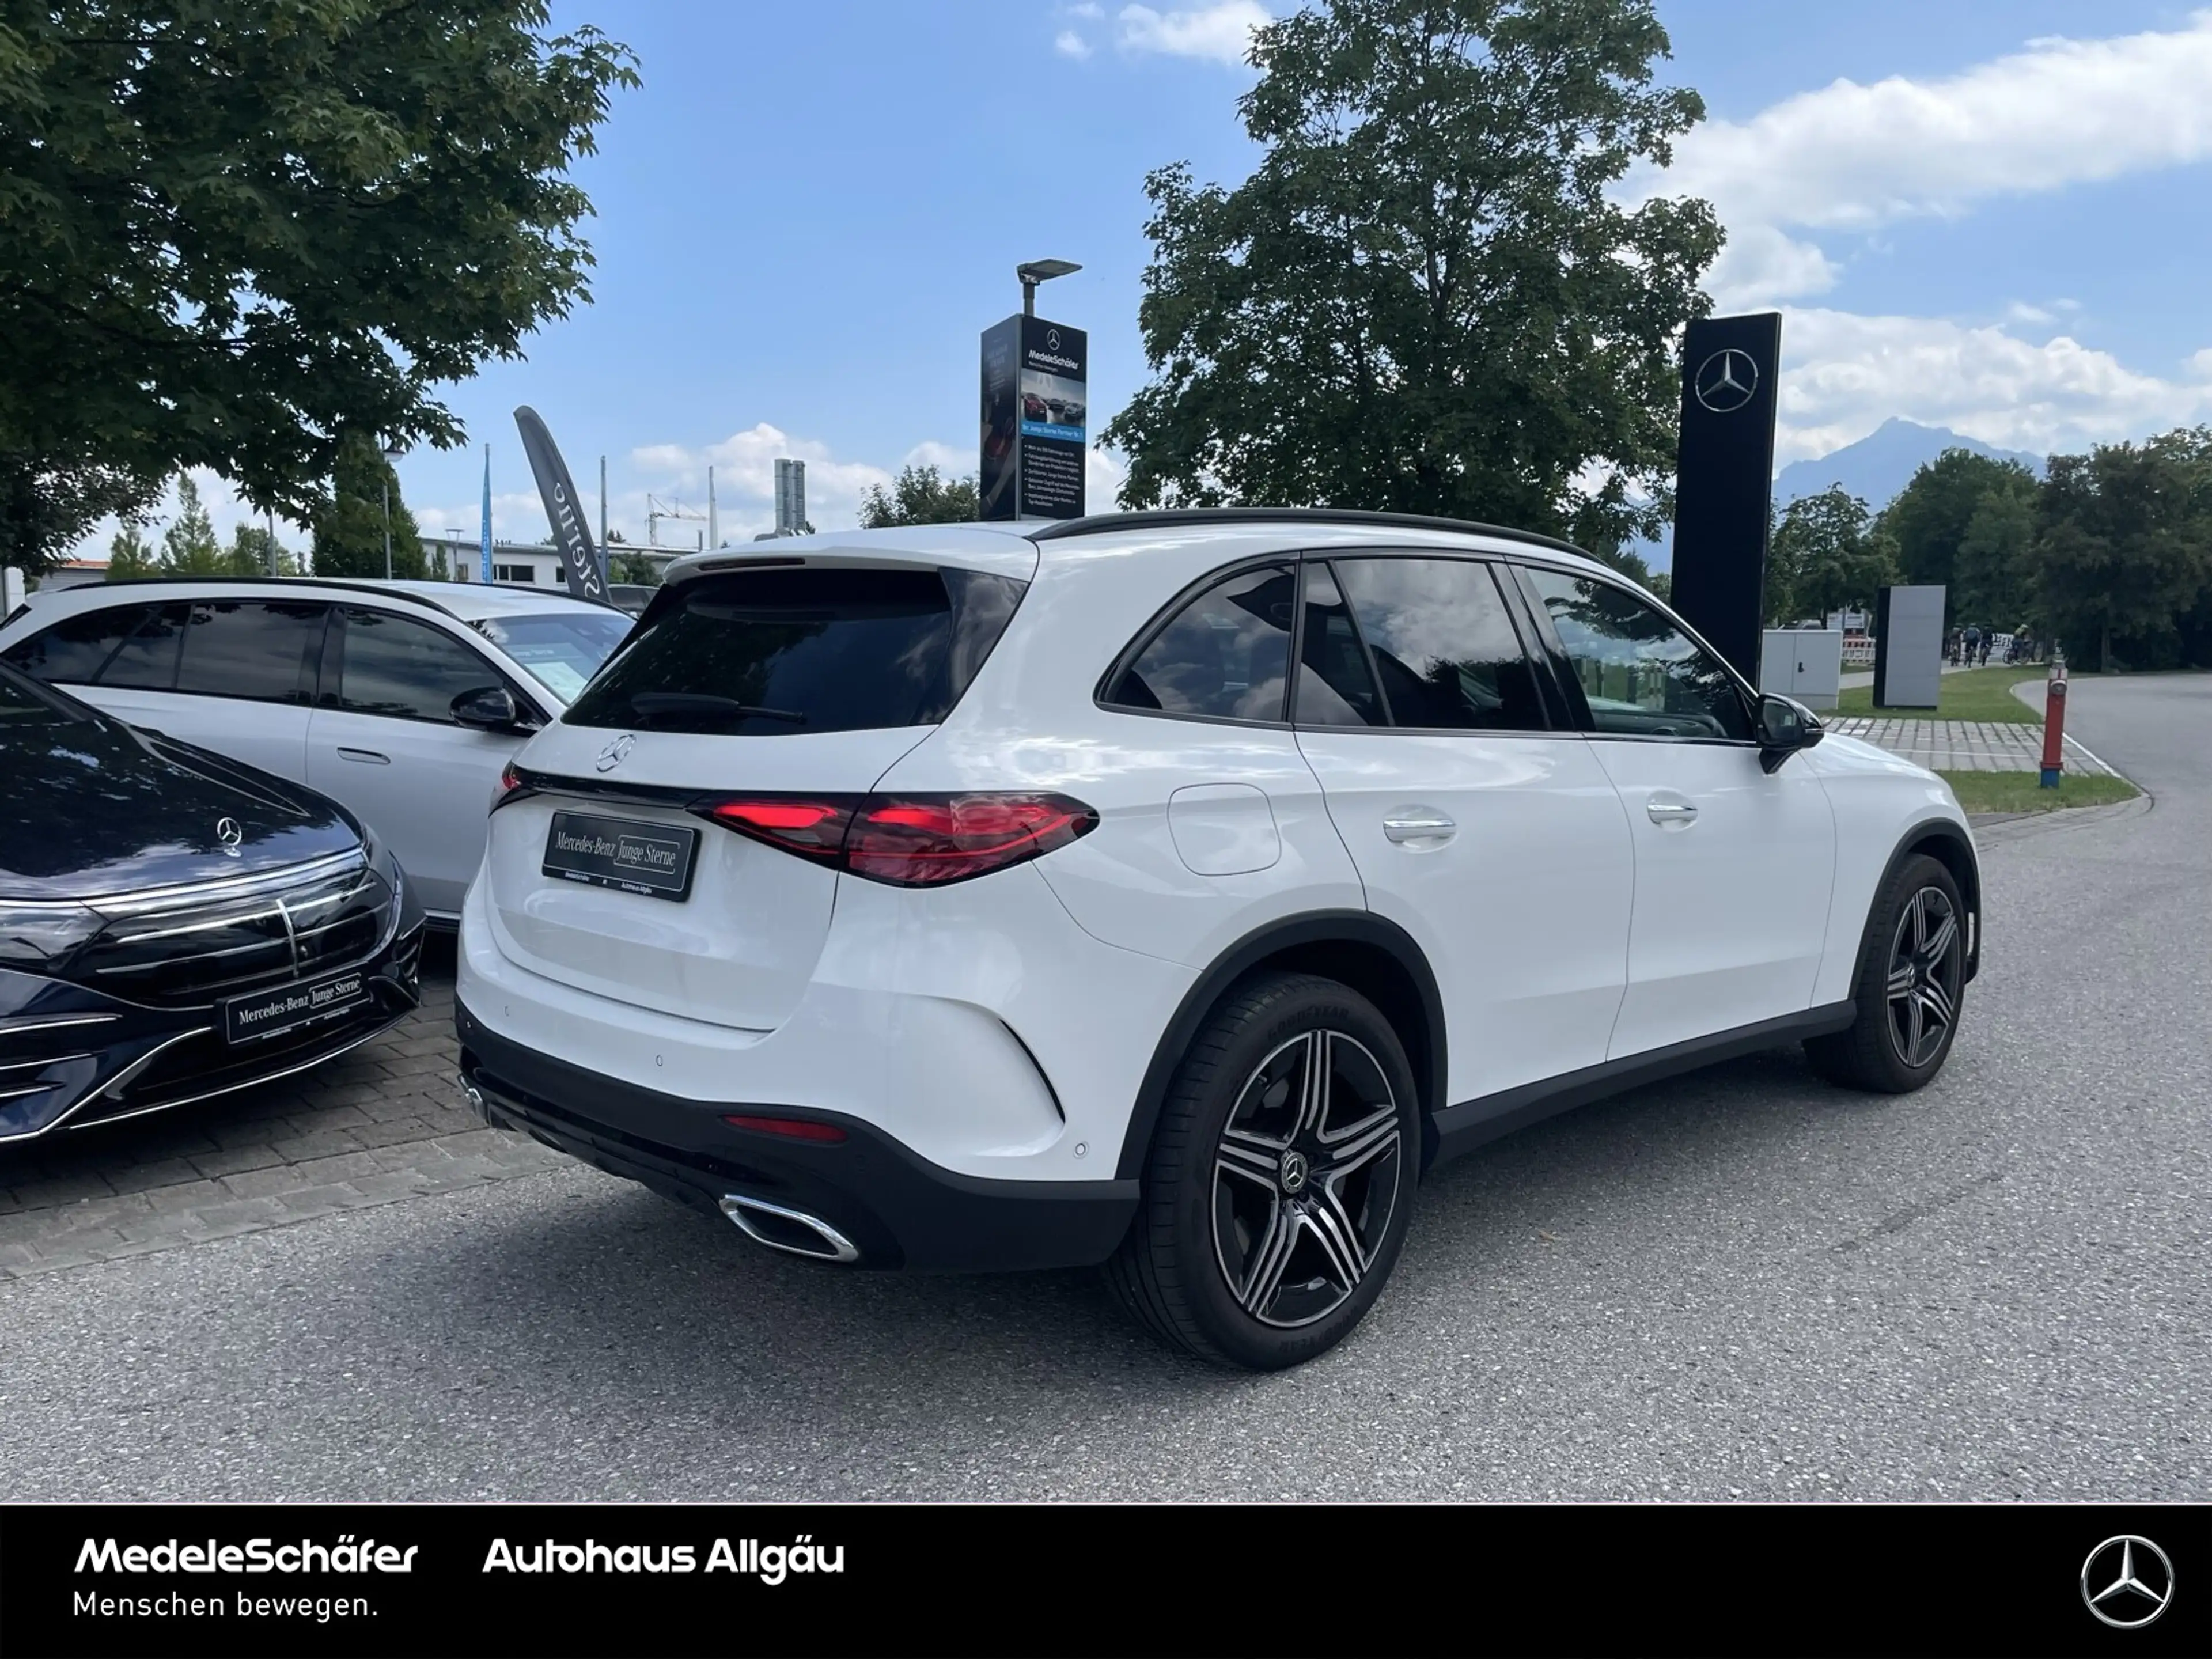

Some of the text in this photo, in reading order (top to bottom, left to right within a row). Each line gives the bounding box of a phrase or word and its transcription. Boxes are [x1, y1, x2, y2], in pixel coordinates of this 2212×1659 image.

[555, 831, 676, 866] Mercedes-Benz Junge Sterne
[238, 994, 309, 1025] Mercedes-Benz
[311, 987, 335, 1005] Junge
[335, 979, 361, 997] Sterne
